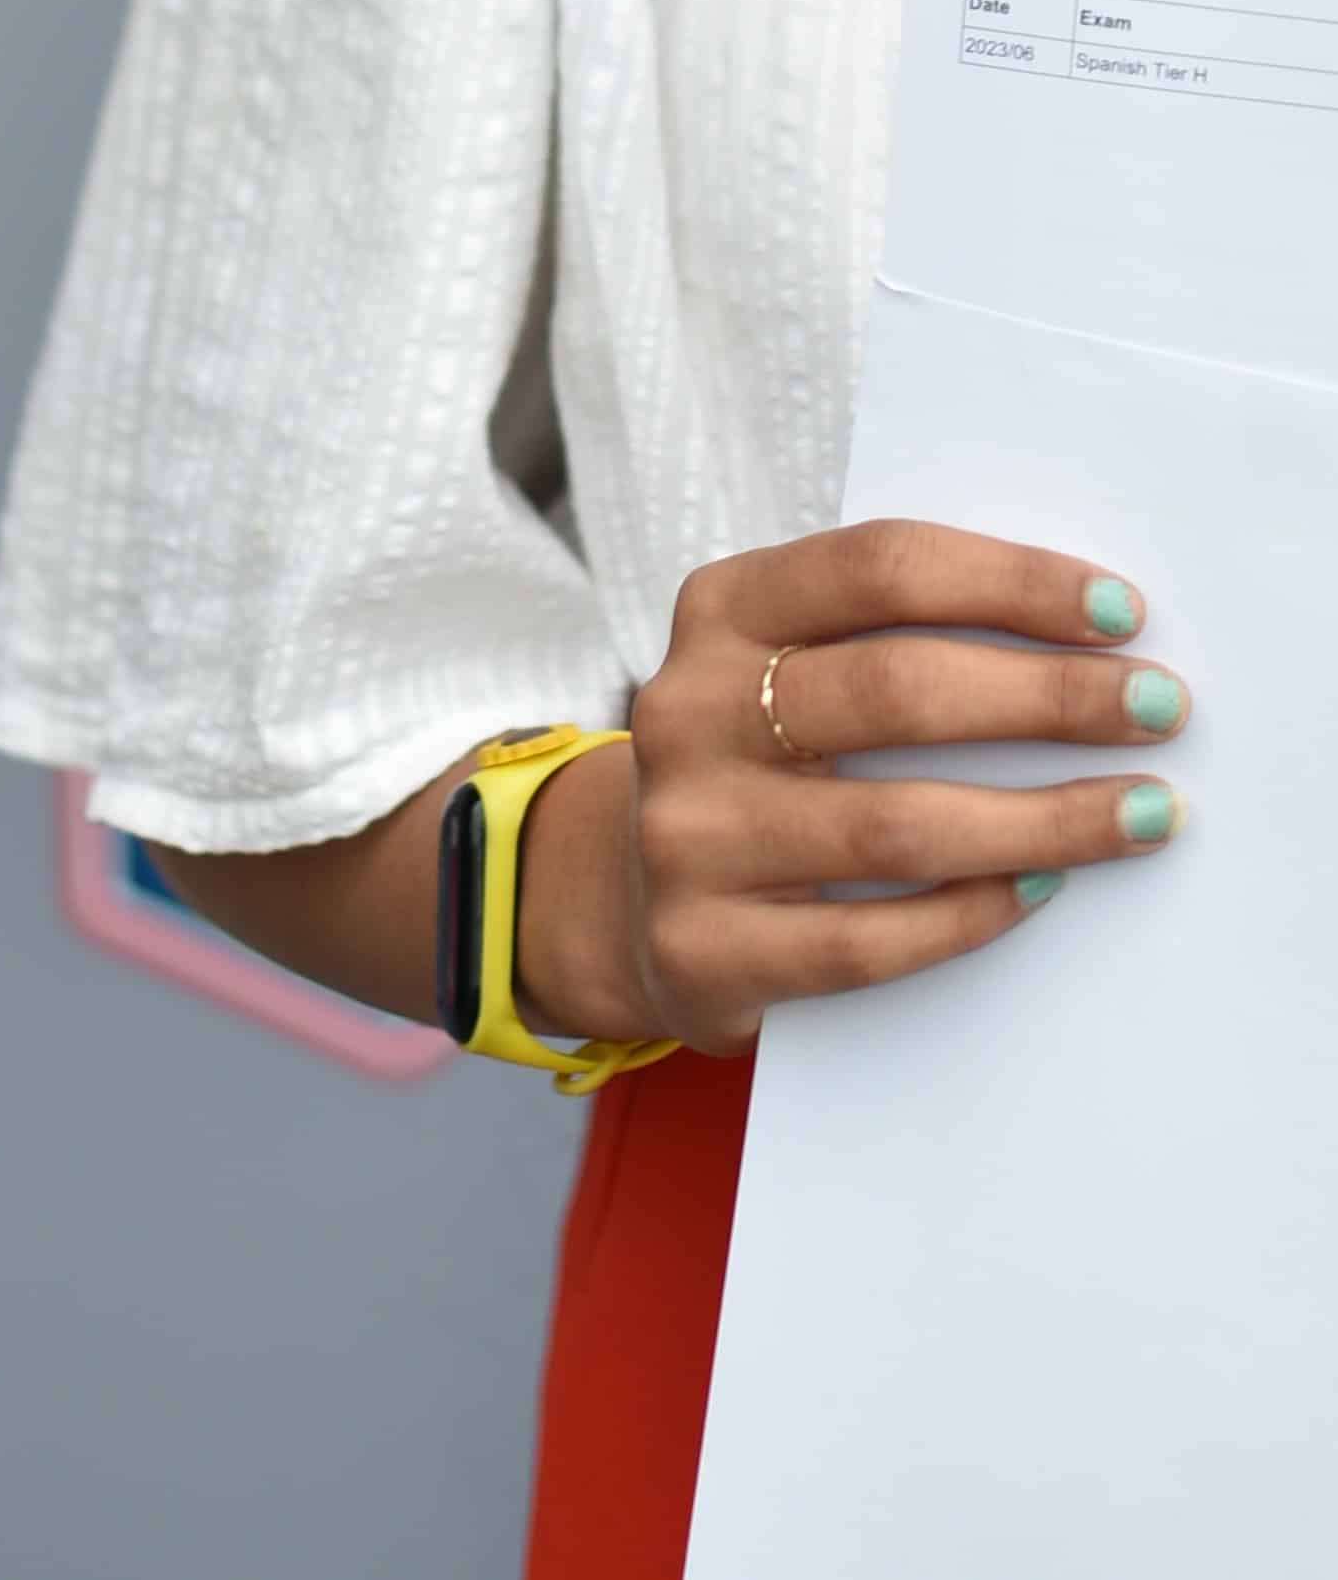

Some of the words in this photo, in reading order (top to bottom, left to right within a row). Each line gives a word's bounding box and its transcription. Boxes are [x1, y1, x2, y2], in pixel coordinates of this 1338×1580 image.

[1078, 10, 1133, 33] Exam
[964, 36, 1036, 63] 2023/06
[1075, 50, 1148, 80] Spanish
[1154, 61, 1189, 84] Tier
[1192, 67, 1209, 86] H
